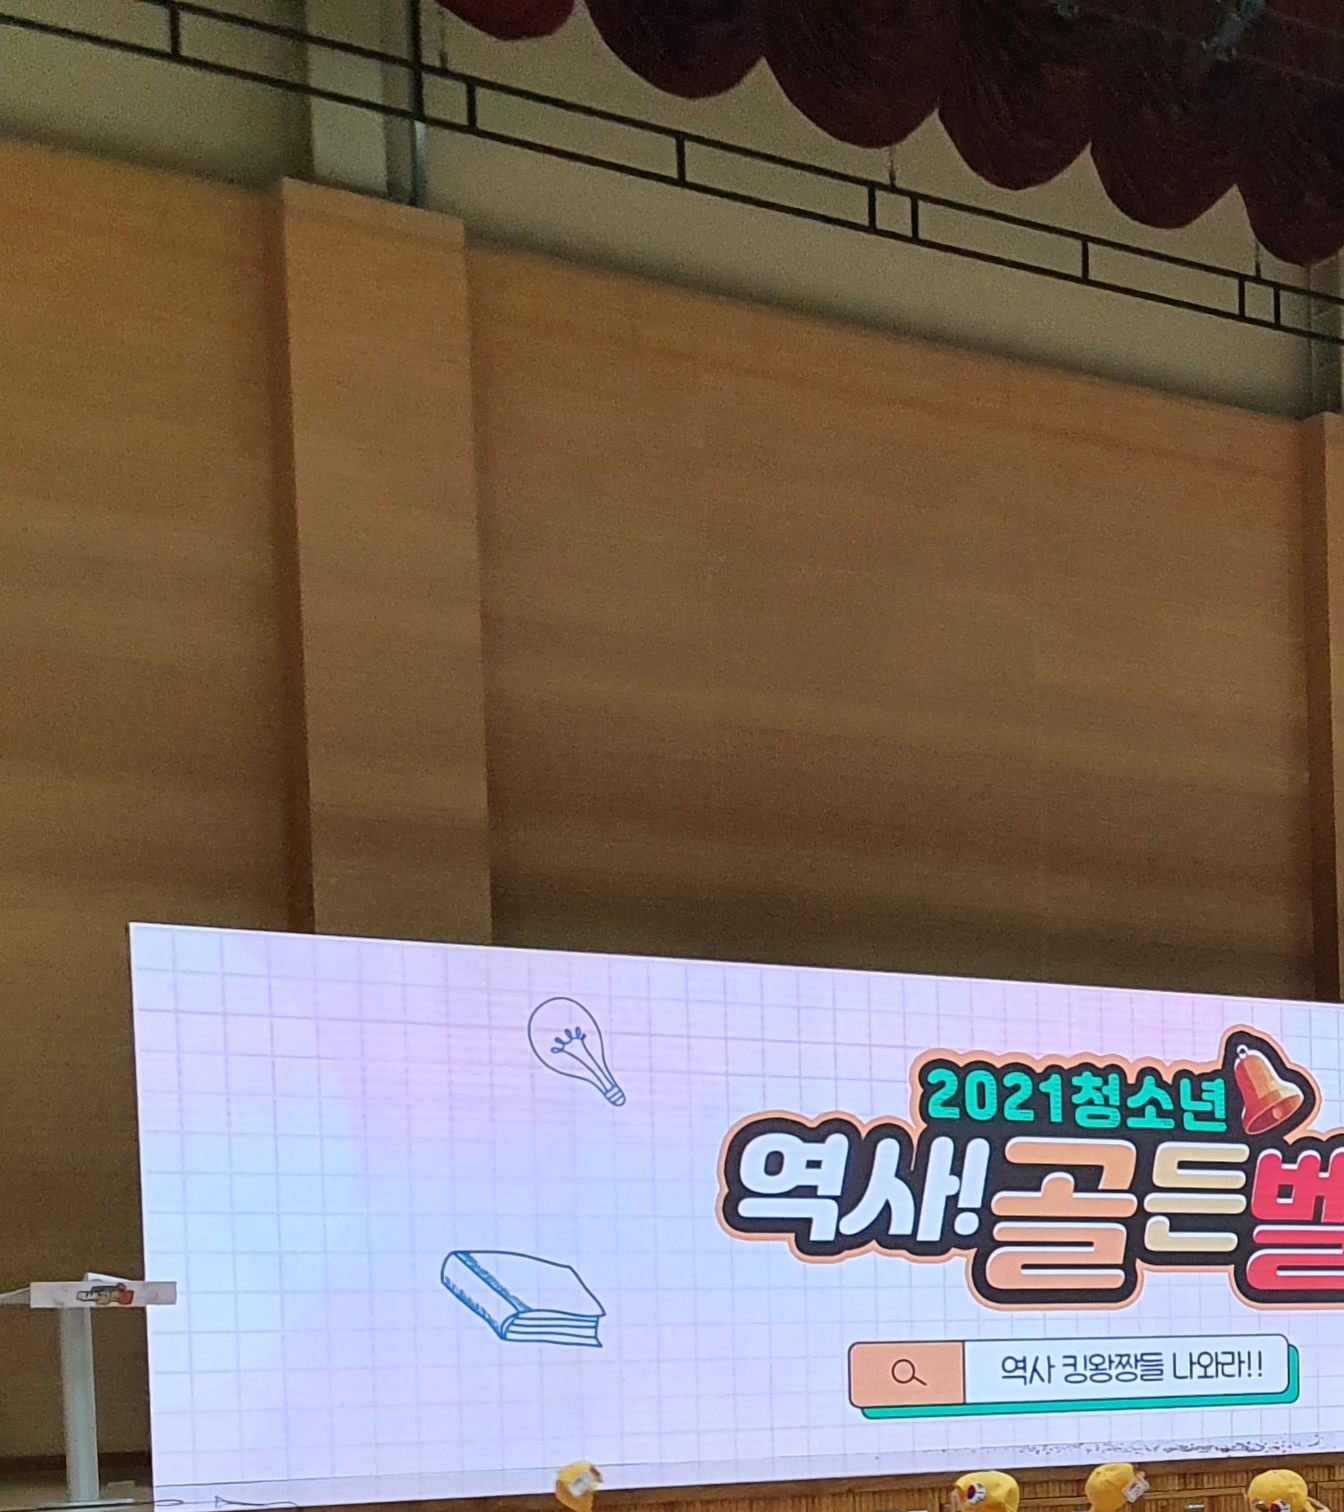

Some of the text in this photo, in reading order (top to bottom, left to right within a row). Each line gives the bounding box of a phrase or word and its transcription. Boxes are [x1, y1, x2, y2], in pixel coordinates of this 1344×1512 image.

[1001, 1350, 1264, 1387] 역사 킹왕짱들 나와라!!
